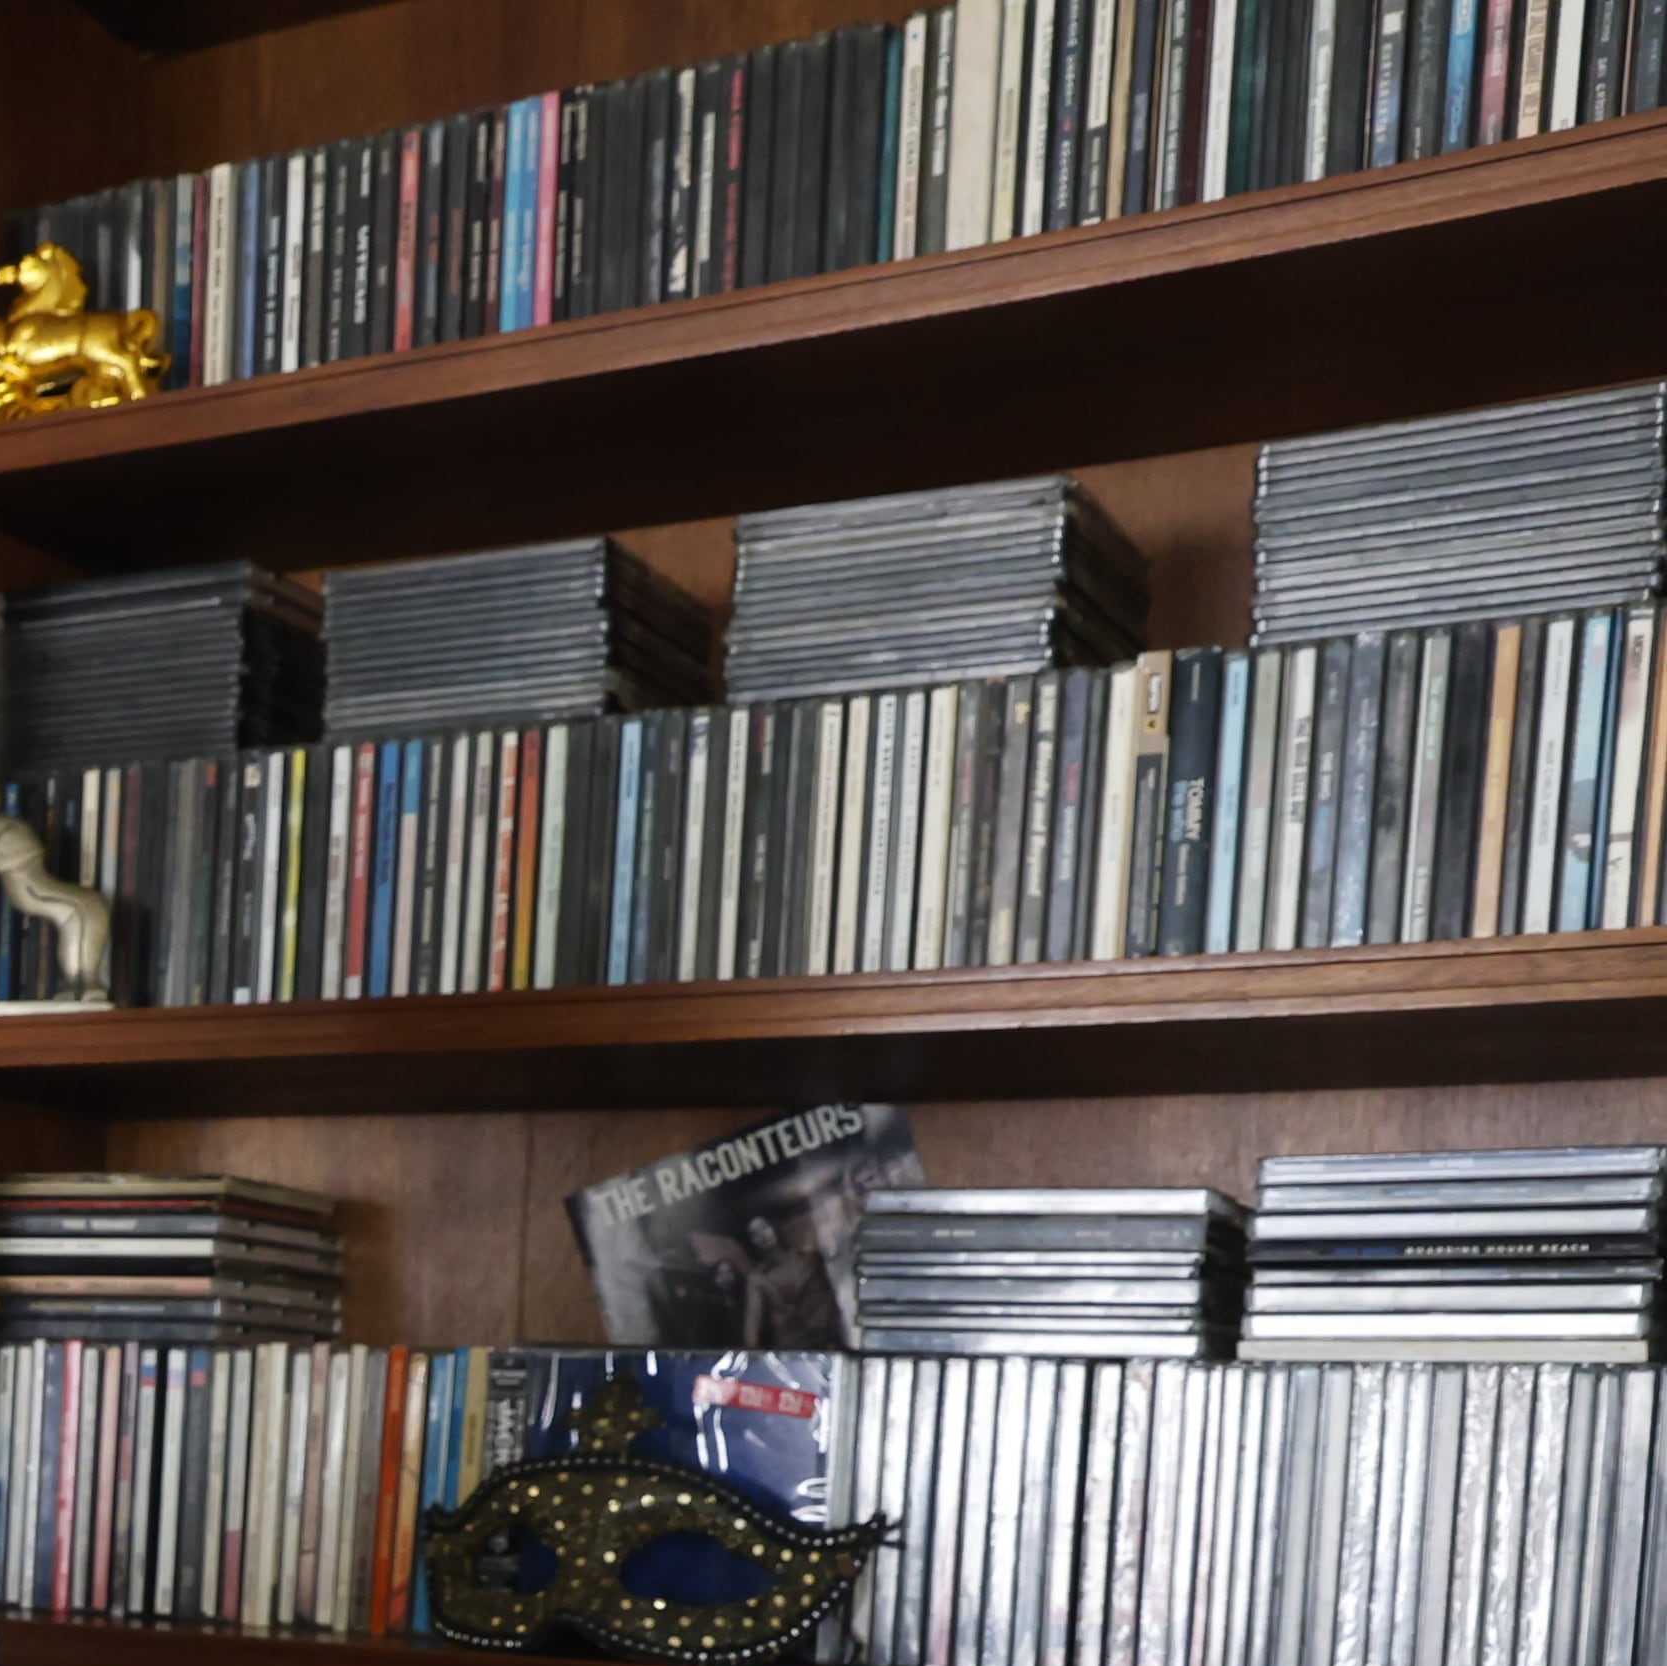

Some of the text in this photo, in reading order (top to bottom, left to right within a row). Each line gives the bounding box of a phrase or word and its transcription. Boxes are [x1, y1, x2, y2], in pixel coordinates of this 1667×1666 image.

[1184, 777, 1206, 841] TOMMY
[593, 1102, 864, 1225] THE RACONTEURS
